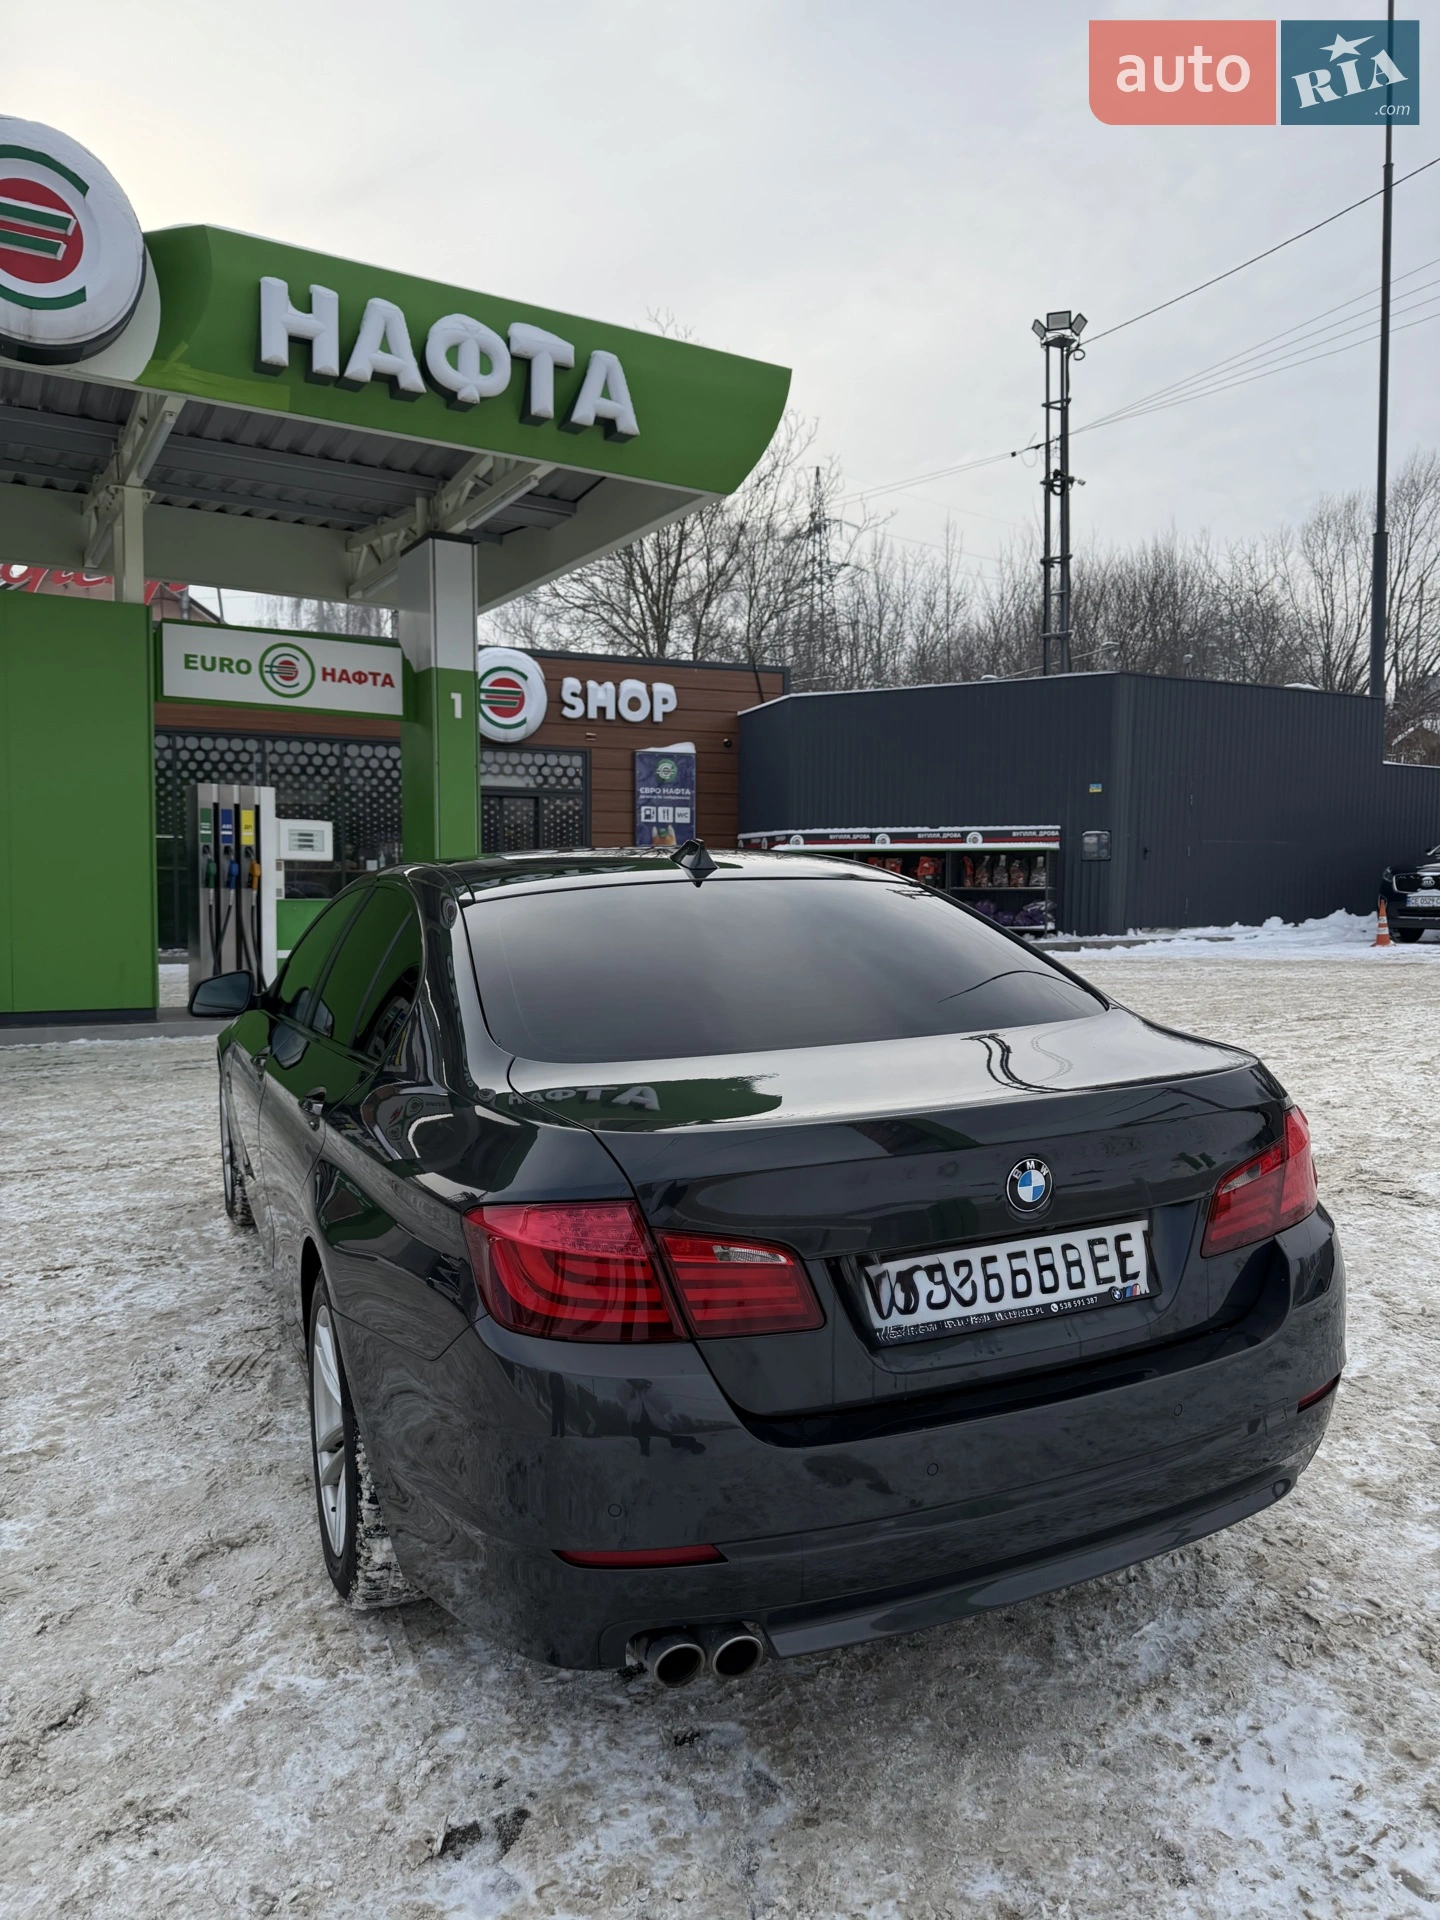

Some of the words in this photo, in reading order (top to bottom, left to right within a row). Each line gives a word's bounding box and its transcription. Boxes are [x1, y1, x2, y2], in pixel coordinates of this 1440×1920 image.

[258, 275, 641, 438] НАФТА
[183, 653, 253, 675] EURO
[321, 666, 396, 688] НАФТА
[450, 692, 462, 719] 1
[560, 676, 678, 724] SHOP
[662, 787, 691, 796] НАФТА
[1012, 1160, 1049, 1180] BMW
